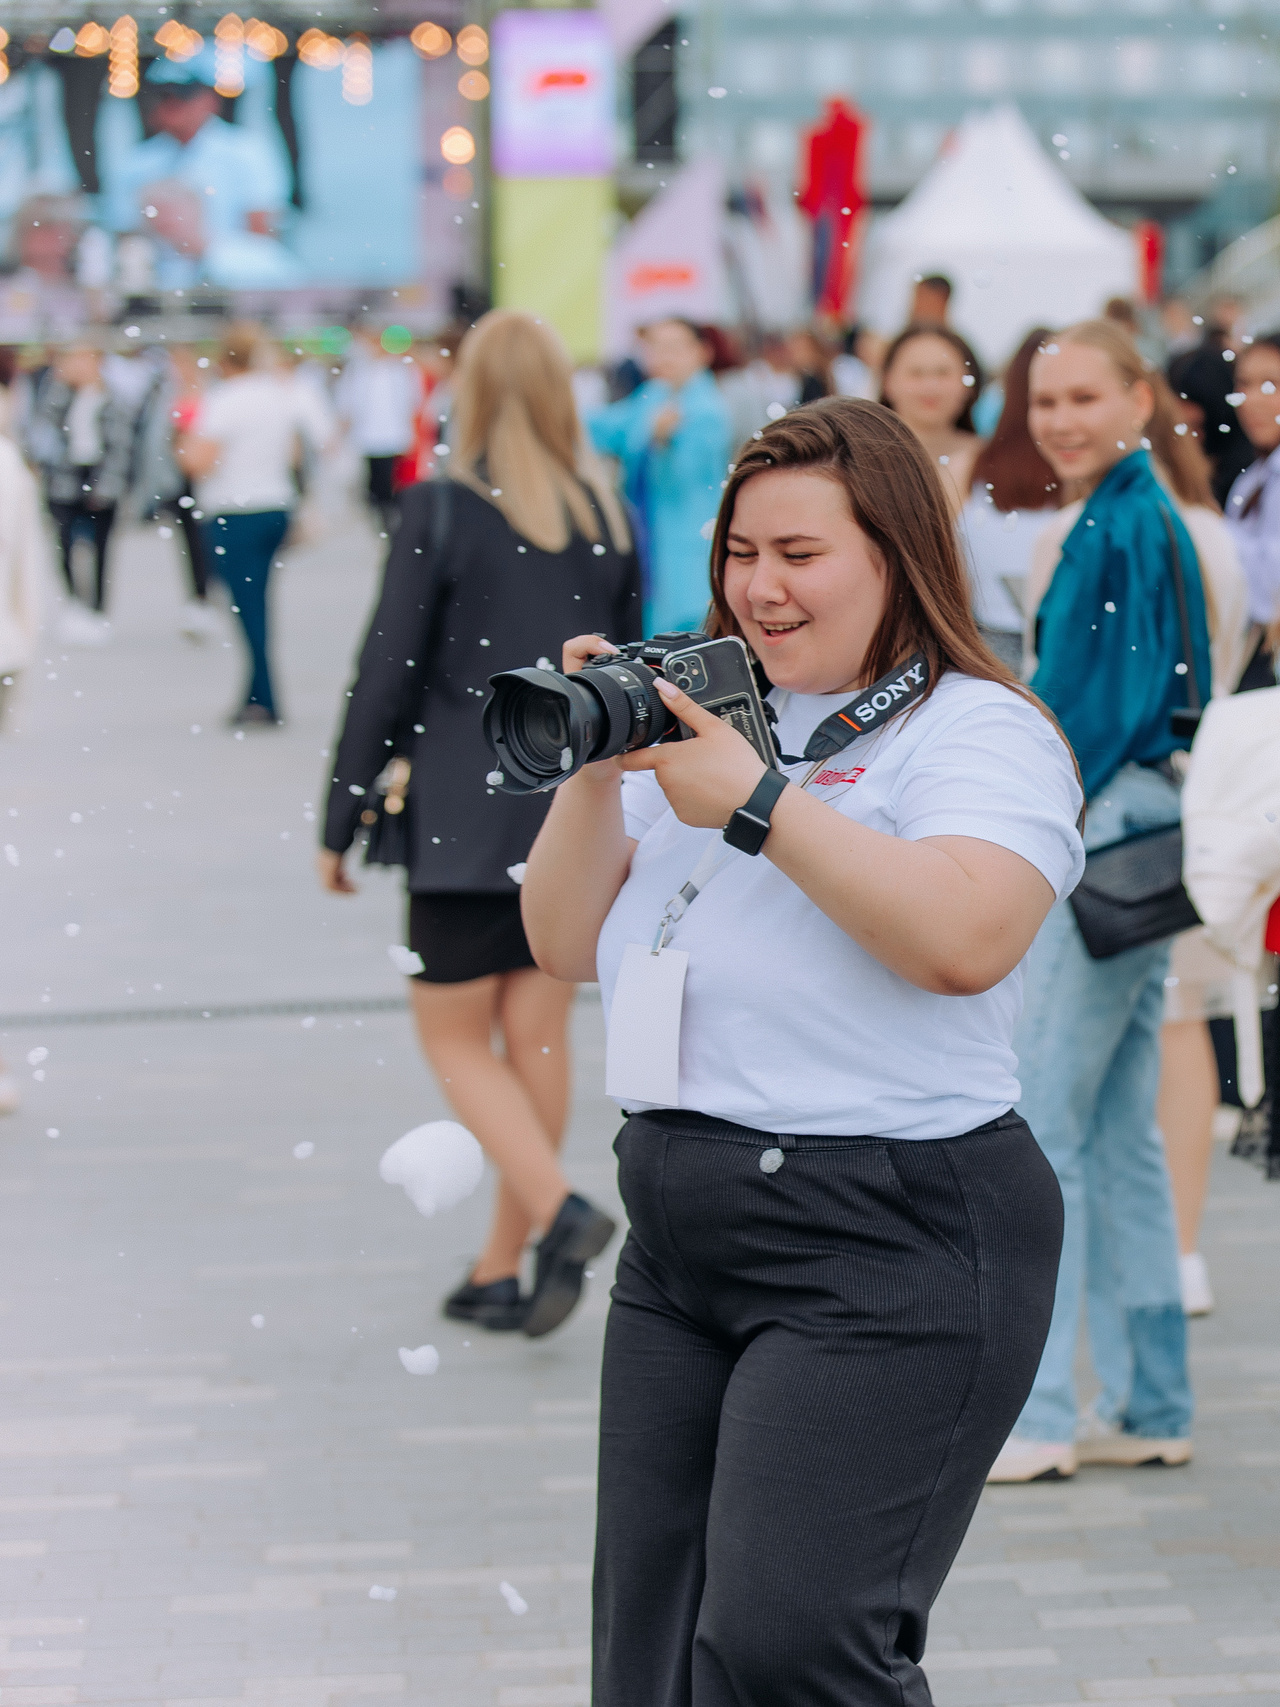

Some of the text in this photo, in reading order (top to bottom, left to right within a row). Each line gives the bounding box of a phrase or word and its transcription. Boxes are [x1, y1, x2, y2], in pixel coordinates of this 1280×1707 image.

[644, 646, 668, 654] SONY
[854, 662, 925, 722] SONY
[741, 704, 754, 741] TNKOFF
